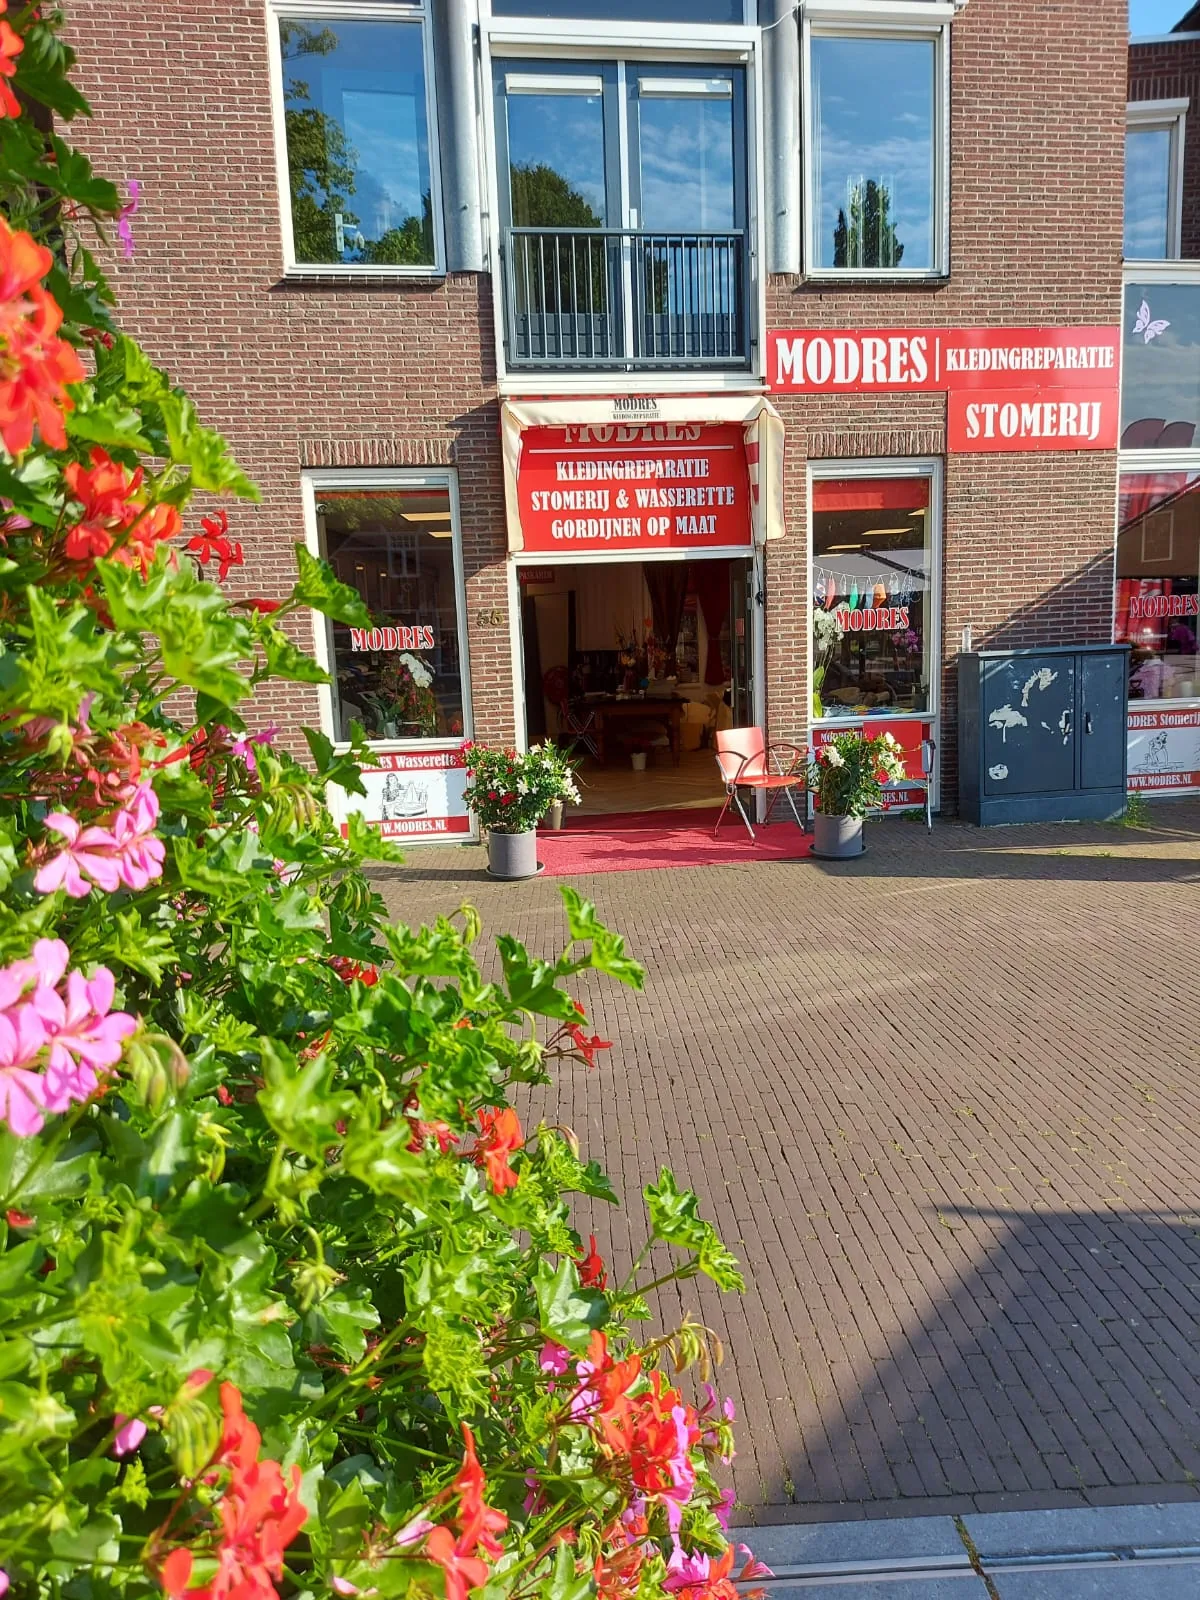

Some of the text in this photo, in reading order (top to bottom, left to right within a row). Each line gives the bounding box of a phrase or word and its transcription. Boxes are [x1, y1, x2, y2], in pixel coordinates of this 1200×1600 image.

[775, 336, 1114, 385] MODRES KLEDINGREPARATIE
[613, 397, 658, 411] MODRES
[966, 402, 1102, 440] STOMERIJ
[556, 458, 709, 481] KLEDINGREPARATIE
[531, 486, 735, 512] STOMERIJ & WASSERETTE
[551, 515, 717, 540] GORDIJNEN OP MAAT
[1130, 594, 1199, 618] MODRES
[835, 606, 910, 632] MODRES
[350, 625, 435, 652] MODRES
[1127, 714, 1158, 728] ODRES
[395, 753, 457, 769] Wasserette
